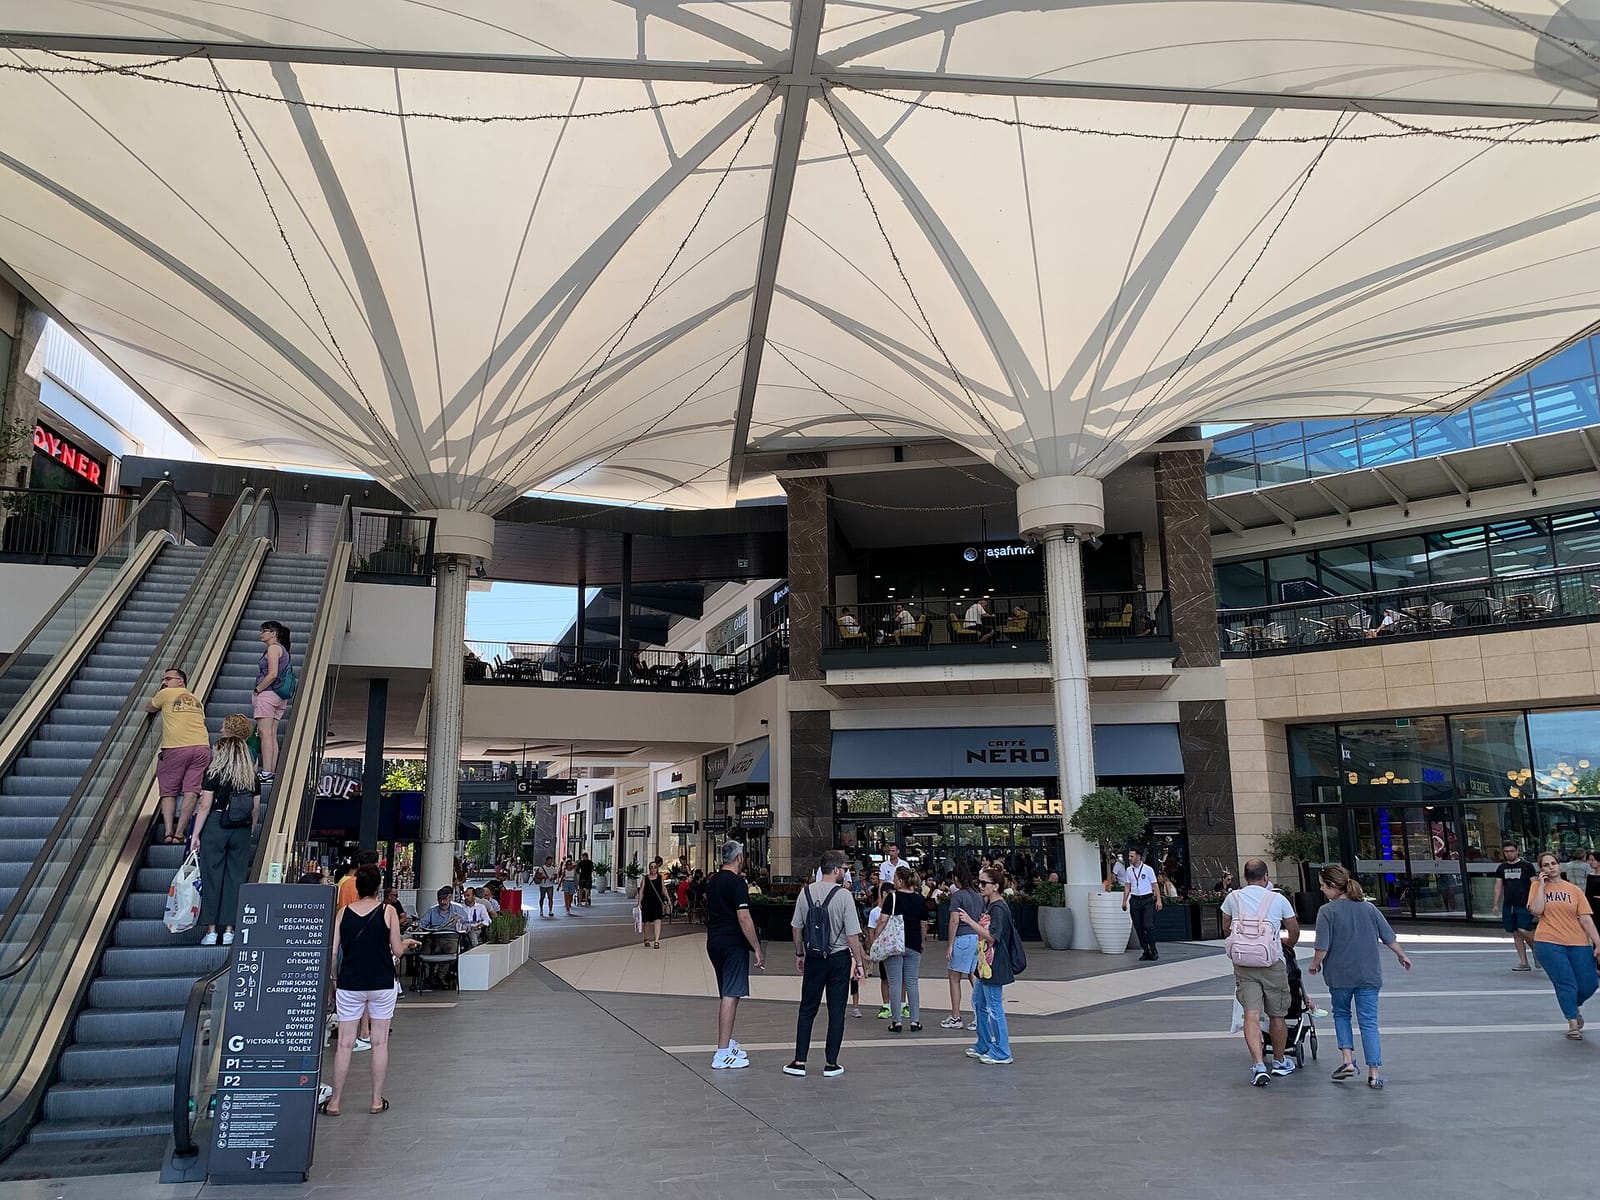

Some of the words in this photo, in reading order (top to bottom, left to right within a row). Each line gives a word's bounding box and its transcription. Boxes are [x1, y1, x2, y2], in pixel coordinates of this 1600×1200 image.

[966, 748, 1050, 764] NERO
[518, 782, 527, 792] G
[228, 1035, 244, 1052] G
[225, 1058, 240, 1069] P1
[223, 1075, 241, 1087] P2
